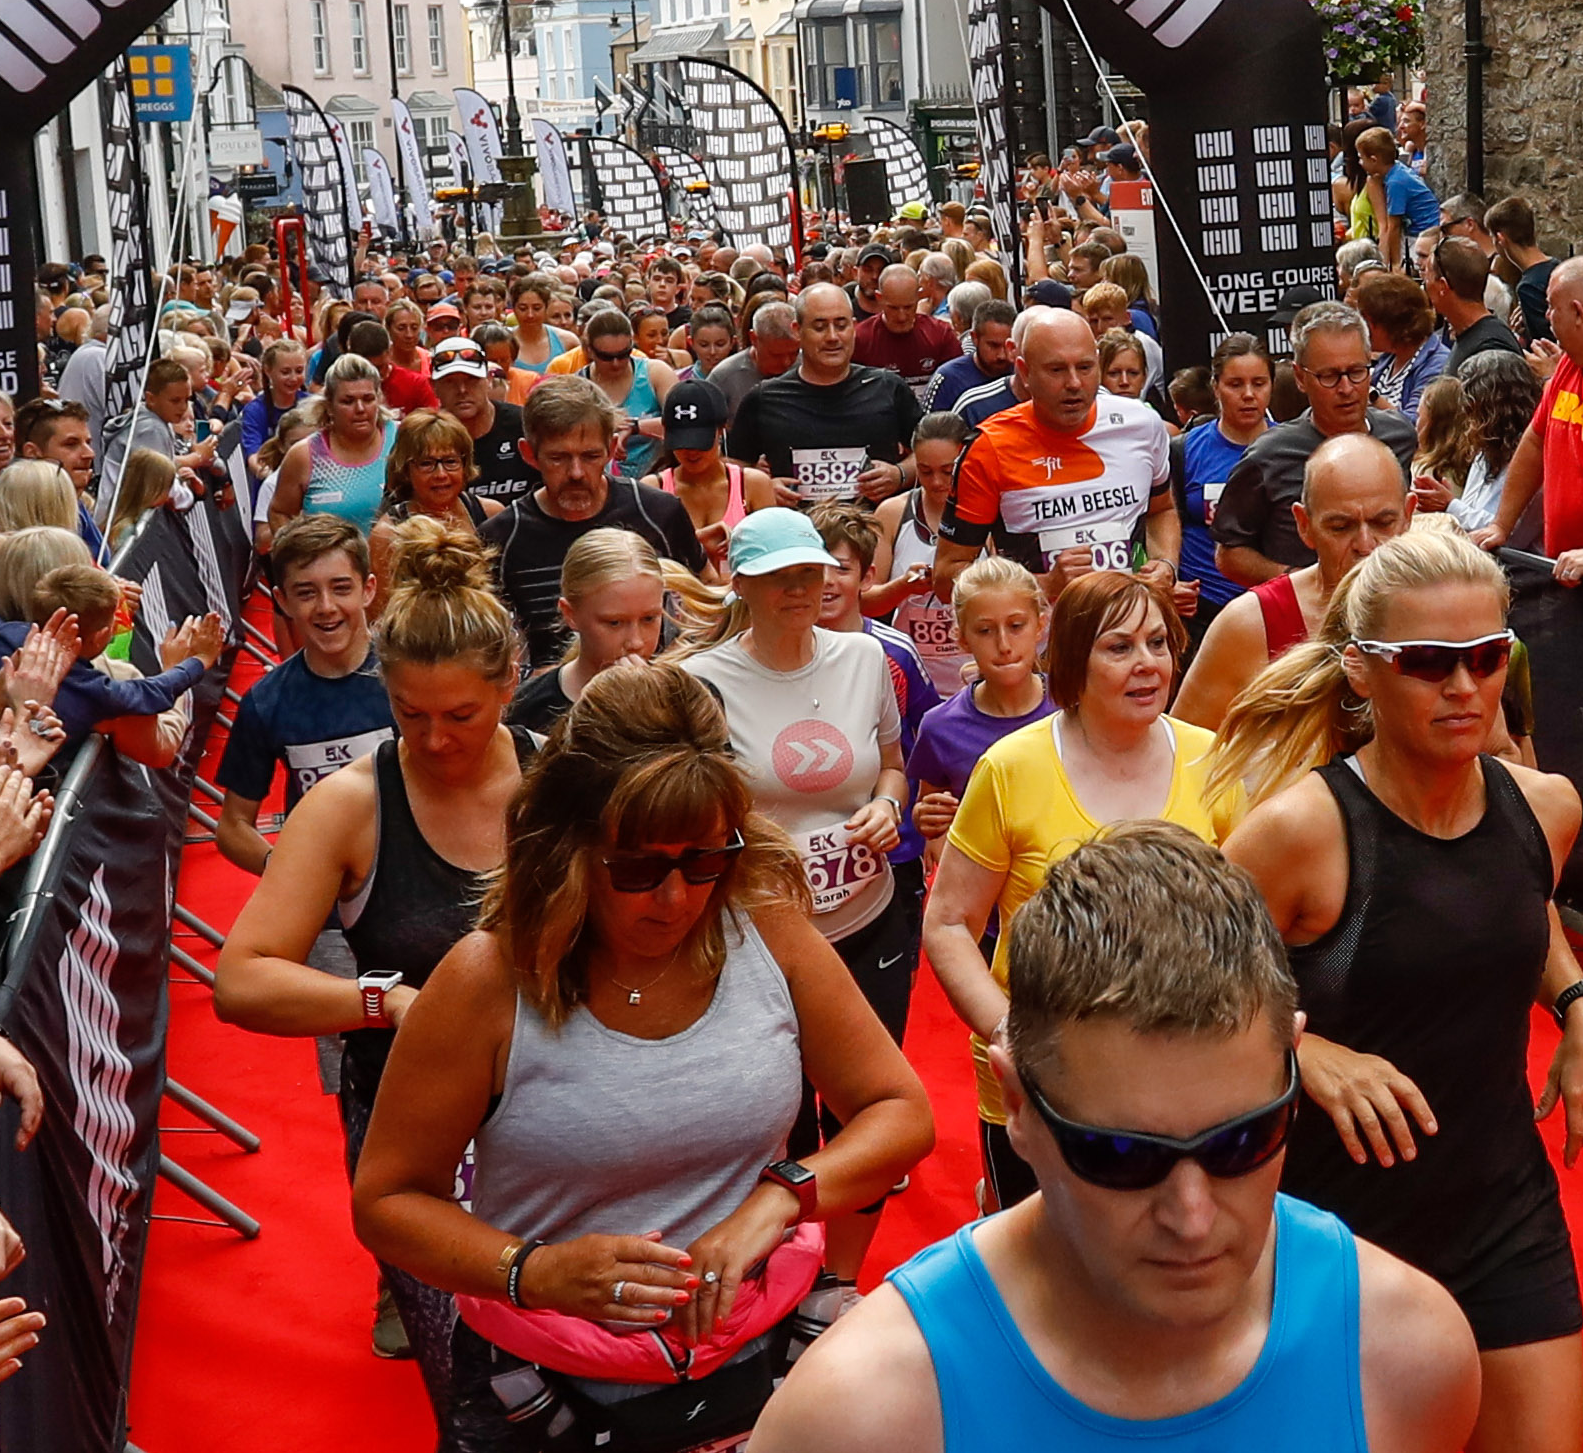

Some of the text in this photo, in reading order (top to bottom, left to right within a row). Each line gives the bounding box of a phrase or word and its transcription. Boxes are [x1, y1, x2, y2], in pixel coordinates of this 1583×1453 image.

[135, 101, 176, 113] GREGGS
[1205, 265, 1335, 291] LONG COURSE
[798, 461, 861, 485] 8582
[469, 478, 528, 496] side
[1032, 485, 1139, 520] TEAM BEESEL
[1075, 530, 1097, 544] 5K
[914, 621, 948, 644] 86
[325, 744, 353, 762] 5K
[809, 832, 837, 853] 5K
[803, 843, 877, 892] 678
[814, 889, 850, 905] Sarah
